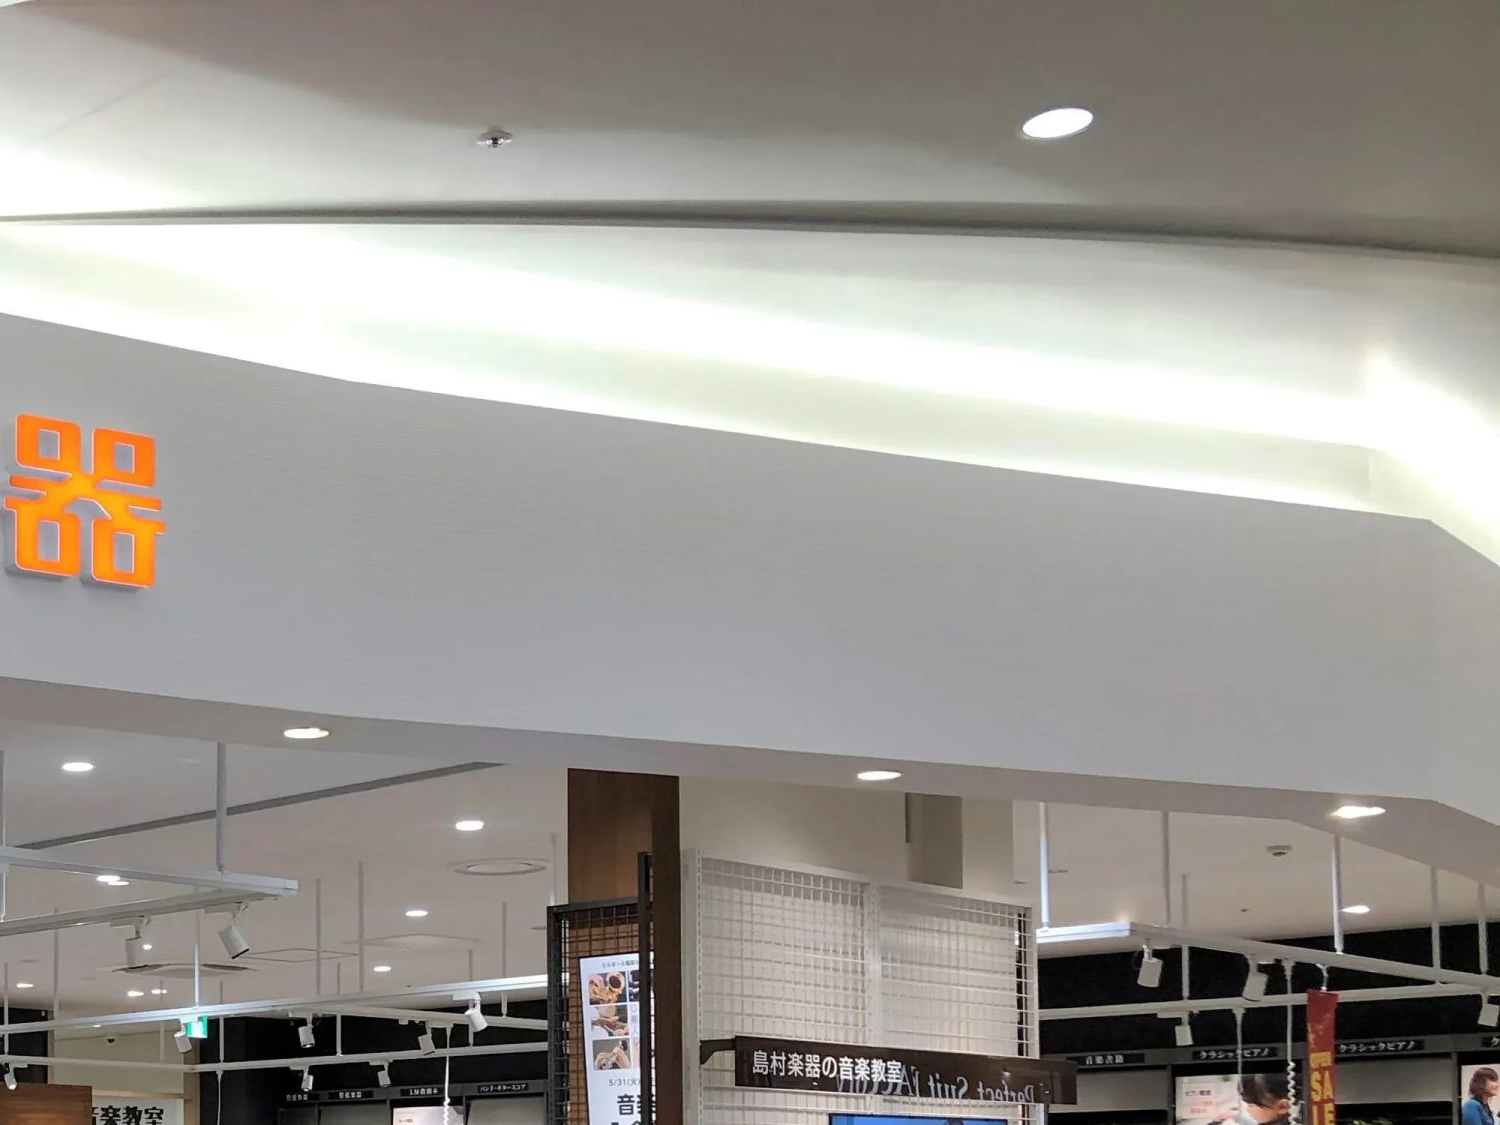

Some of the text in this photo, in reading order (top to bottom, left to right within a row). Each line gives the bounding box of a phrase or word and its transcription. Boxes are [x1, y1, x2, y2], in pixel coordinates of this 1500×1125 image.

[753, 1050, 902, 1084] 島村楽器の音楽教室
